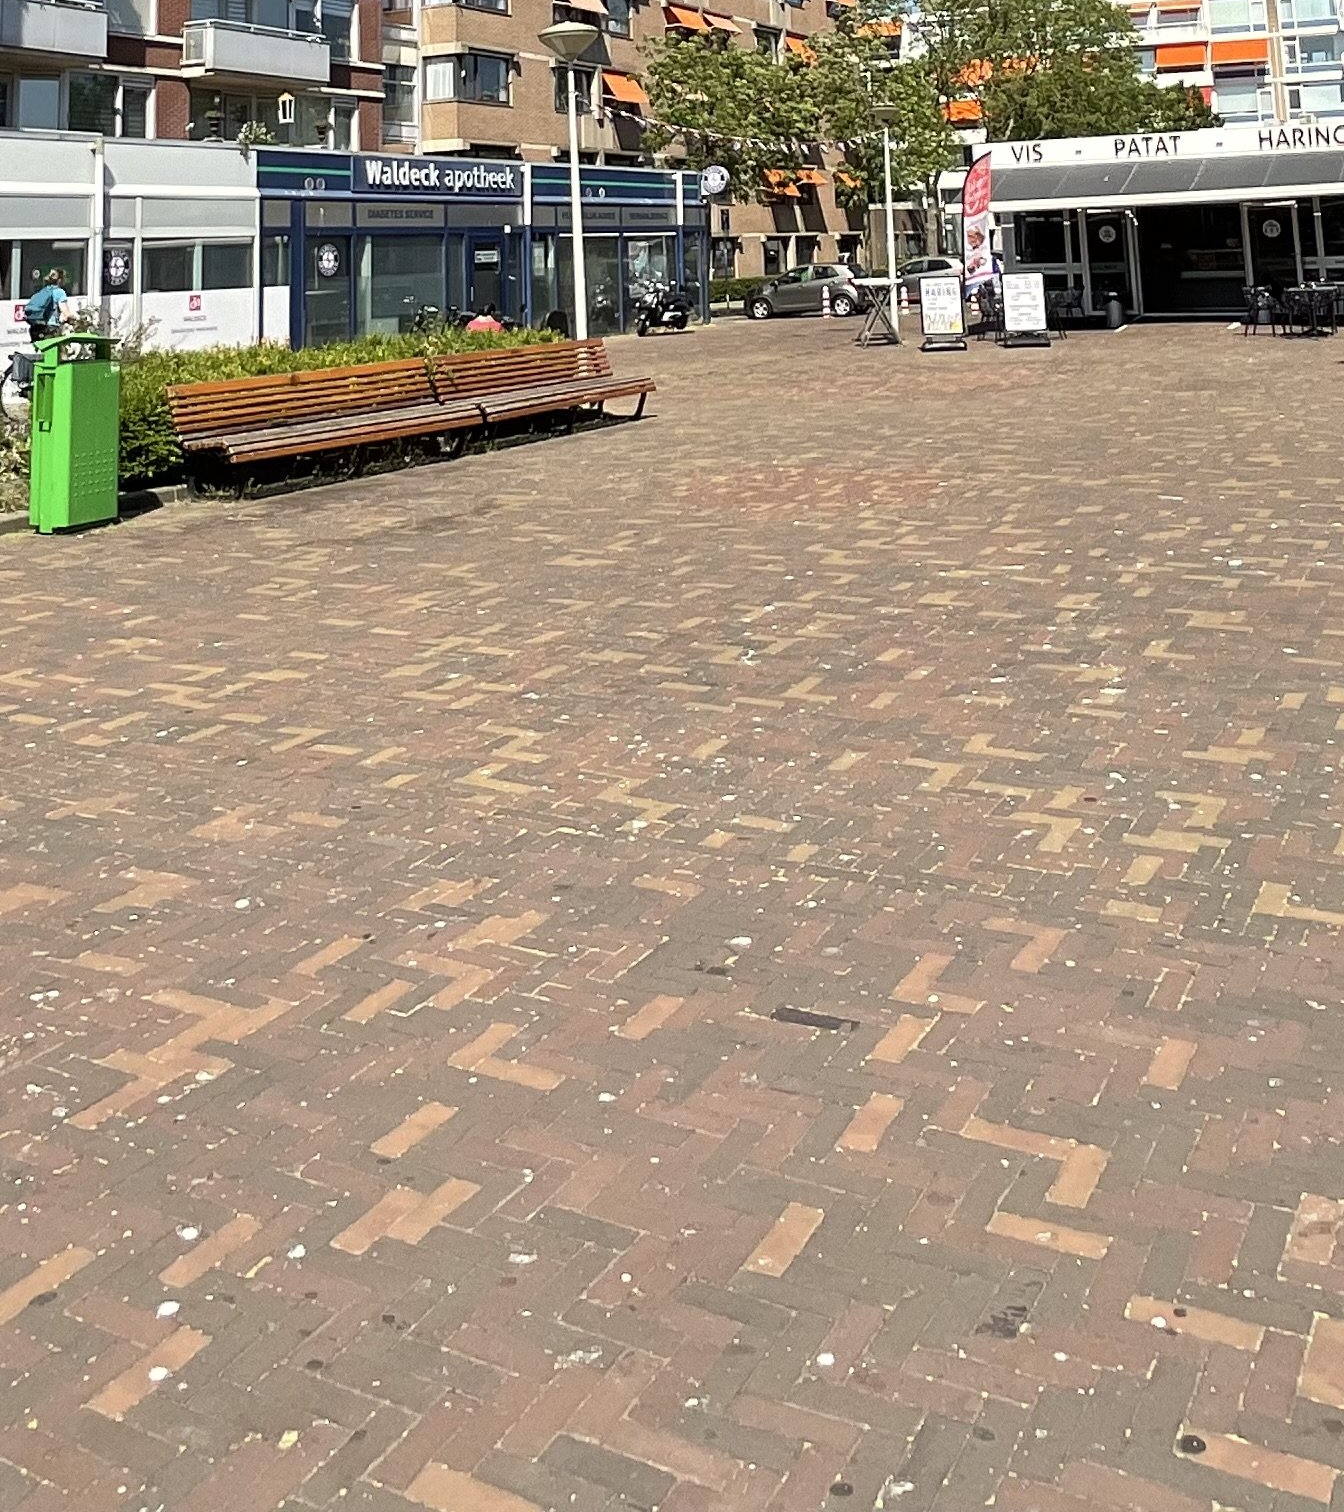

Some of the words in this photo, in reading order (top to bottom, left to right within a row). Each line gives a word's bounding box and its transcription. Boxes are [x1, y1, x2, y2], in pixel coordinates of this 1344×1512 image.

[1011, 143, 1044, 163] VIS
[1114, 135, 1181, 157] PATAT
[365, 160, 440, 188] Waldeck
[444, 164, 516, 194] apotheek
